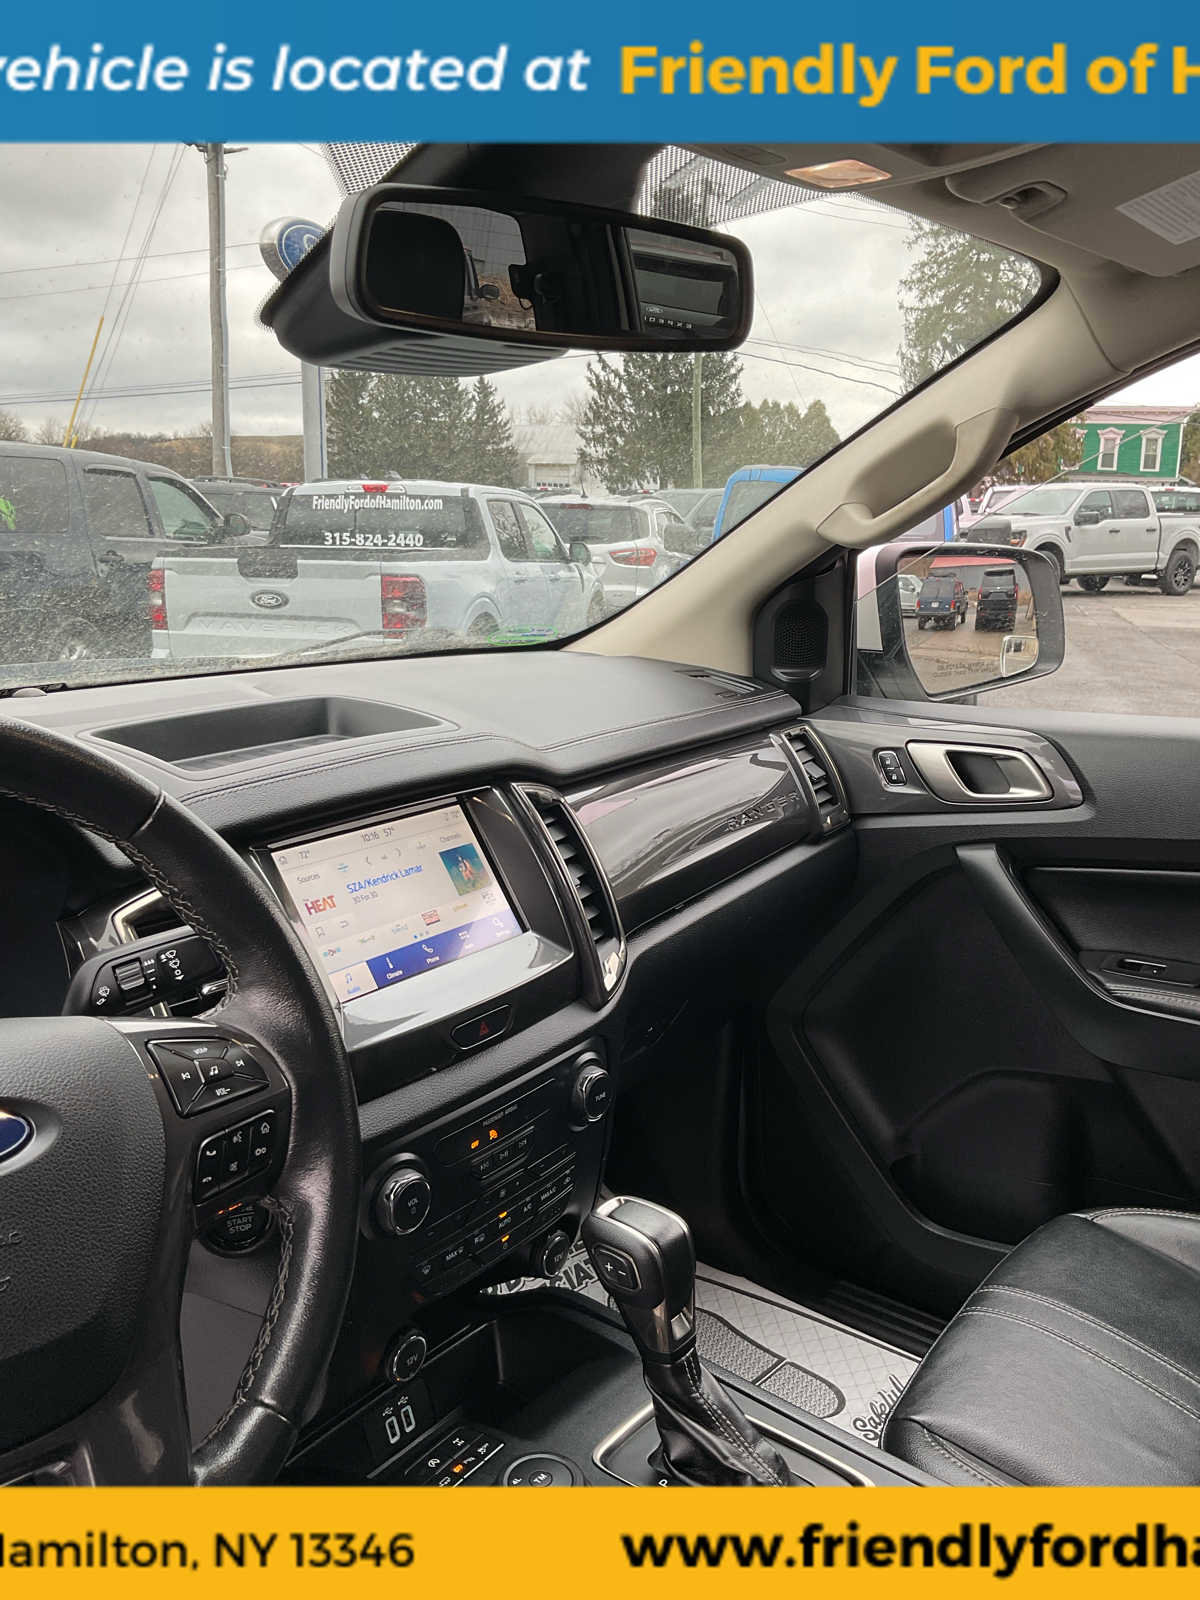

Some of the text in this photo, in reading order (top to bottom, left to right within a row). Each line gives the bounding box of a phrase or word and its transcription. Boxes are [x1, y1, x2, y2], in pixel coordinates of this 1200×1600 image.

[312, 495, 443, 513] FriendlyFordofHamilton.com
[323, 532, 424, 547] 315-824-2440
[727, 791, 800, 832] RANGER
[346, 870, 400, 894] SZA/Kendrick
[304, 895, 337, 916] HEAT
[226, 1216, 253, 1228] START
[228, 1223, 252, 1234] STOP
